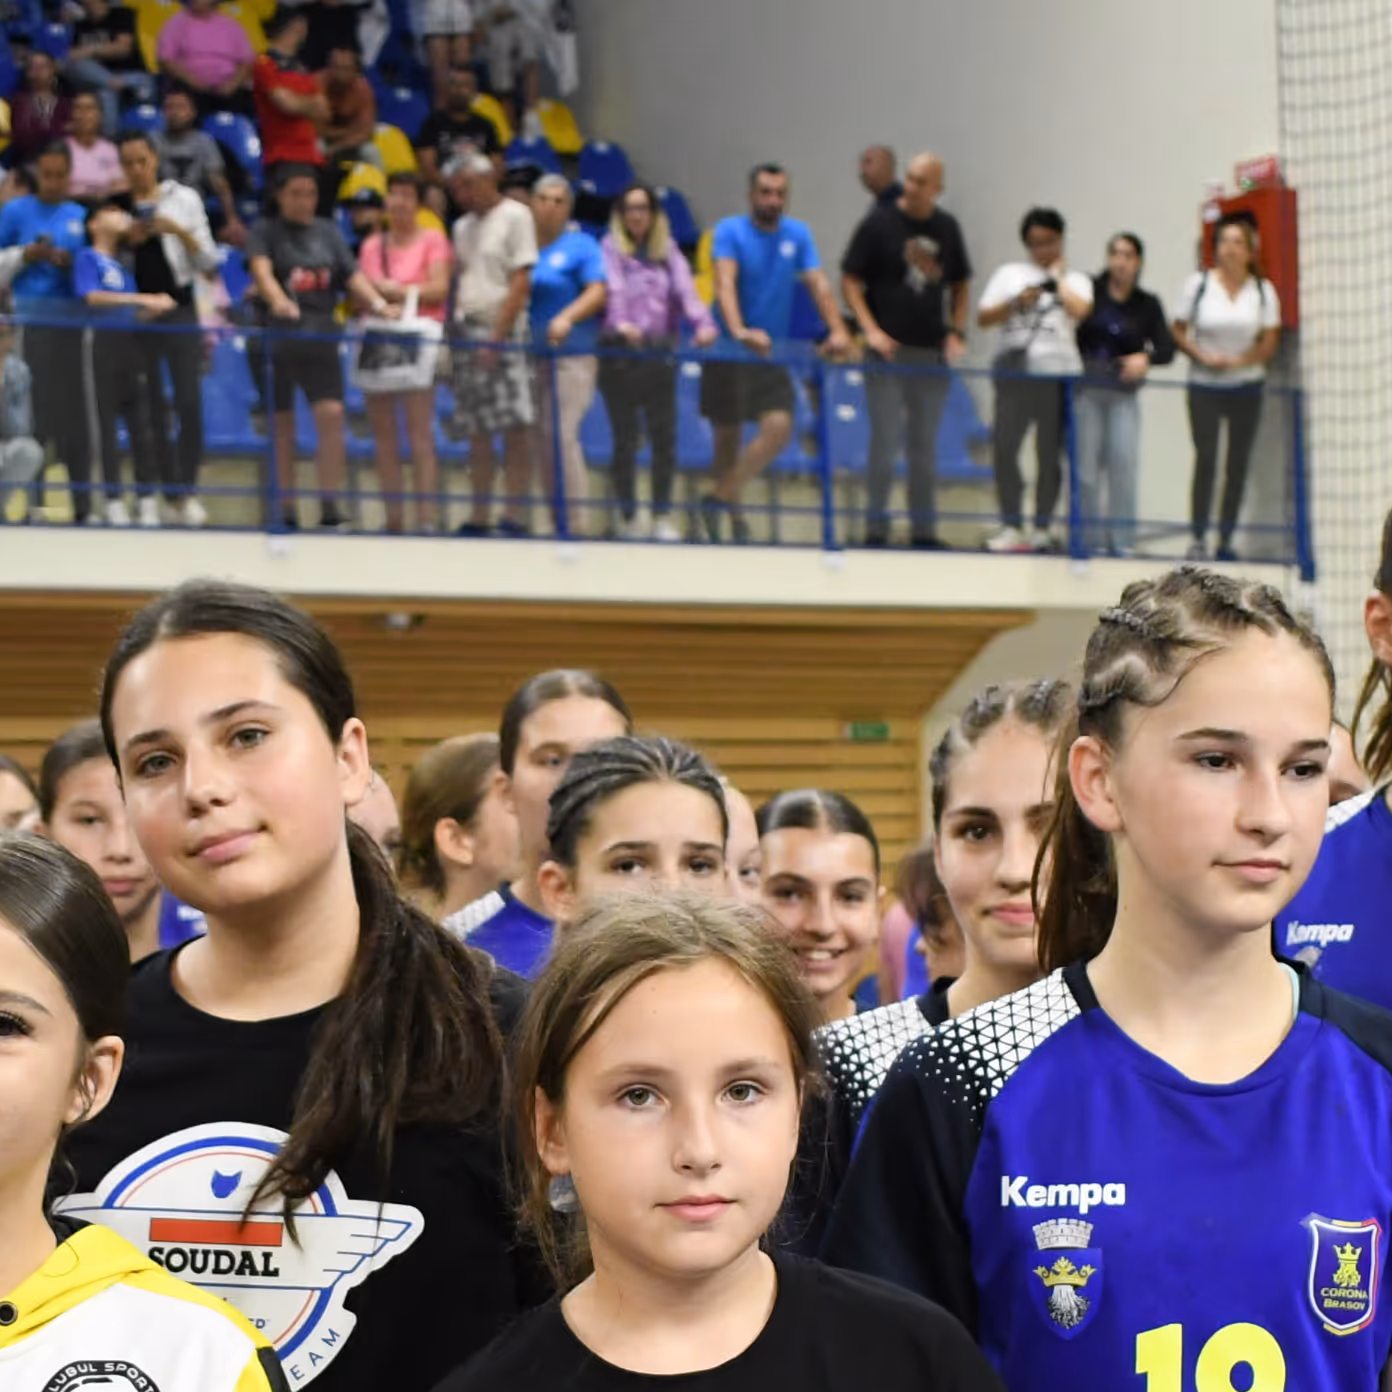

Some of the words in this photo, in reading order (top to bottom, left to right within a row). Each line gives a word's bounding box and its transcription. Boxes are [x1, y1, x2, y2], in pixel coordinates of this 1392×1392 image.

[1000, 1175, 1126, 1215] Kempa
[1320, 1287, 1368, 1300] CORONA
[289, 1328, 341, 1381] EAM
